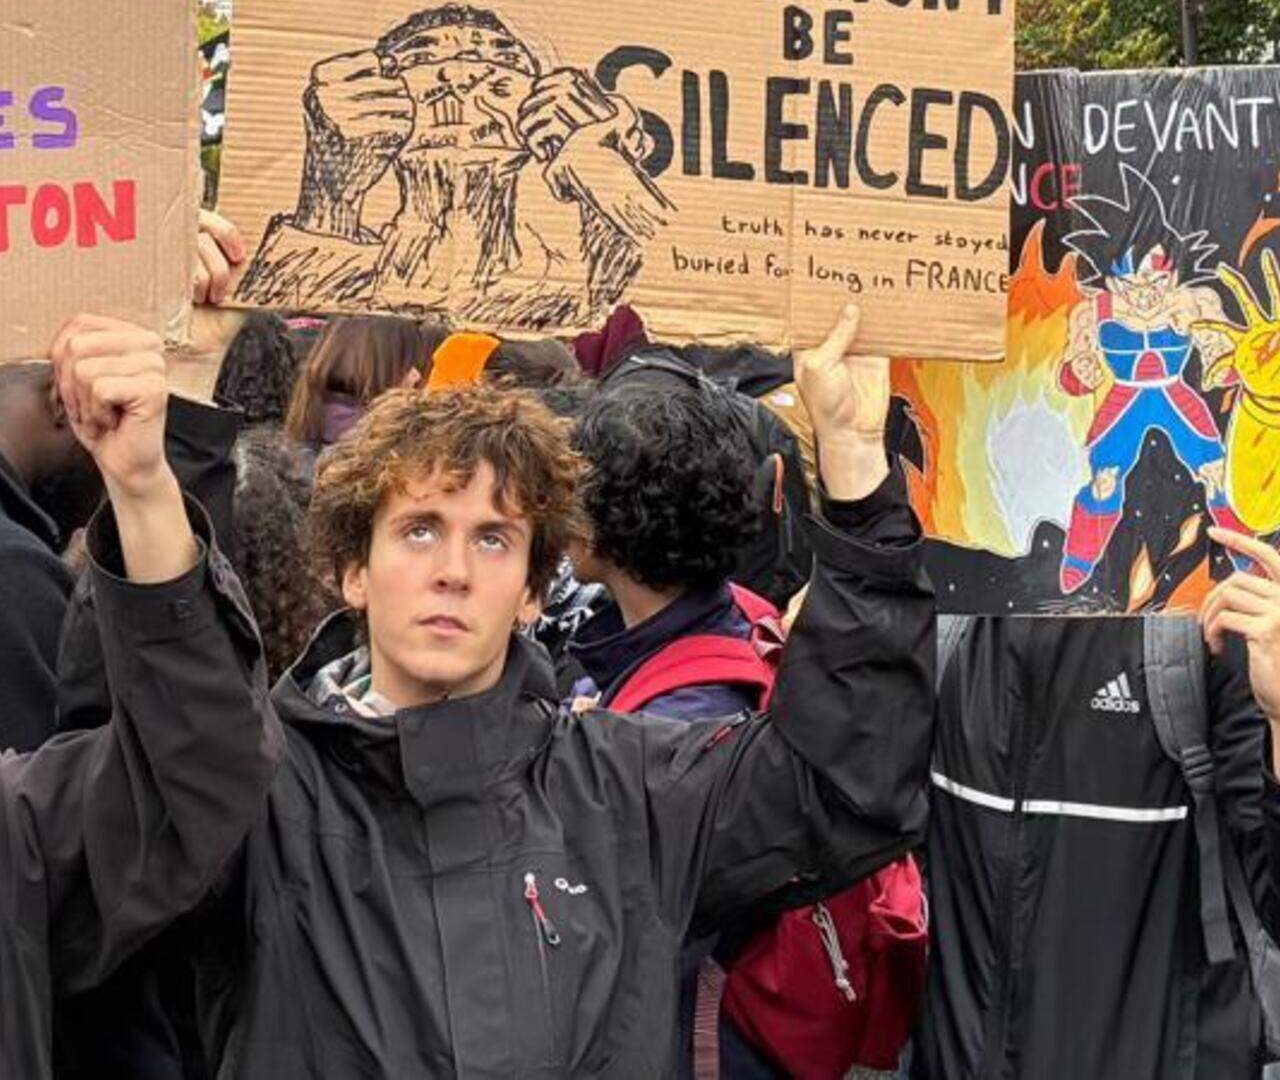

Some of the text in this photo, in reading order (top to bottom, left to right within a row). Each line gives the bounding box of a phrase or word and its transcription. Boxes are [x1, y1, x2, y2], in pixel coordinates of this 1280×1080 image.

[782, 3, 856, 66] BE
[595, 44, 1012, 202] SILENCED
[1082, 96, 1275, 155] DEVANT
[721, 215, 1010, 255] truth has never stayed
[671, 245, 750, 276] buried
[807, 254, 864, 295] long
[872, 274, 895, 289] in
[905, 258, 1010, 295] FRANCE
[1090, 696, 1141, 713] adidas
